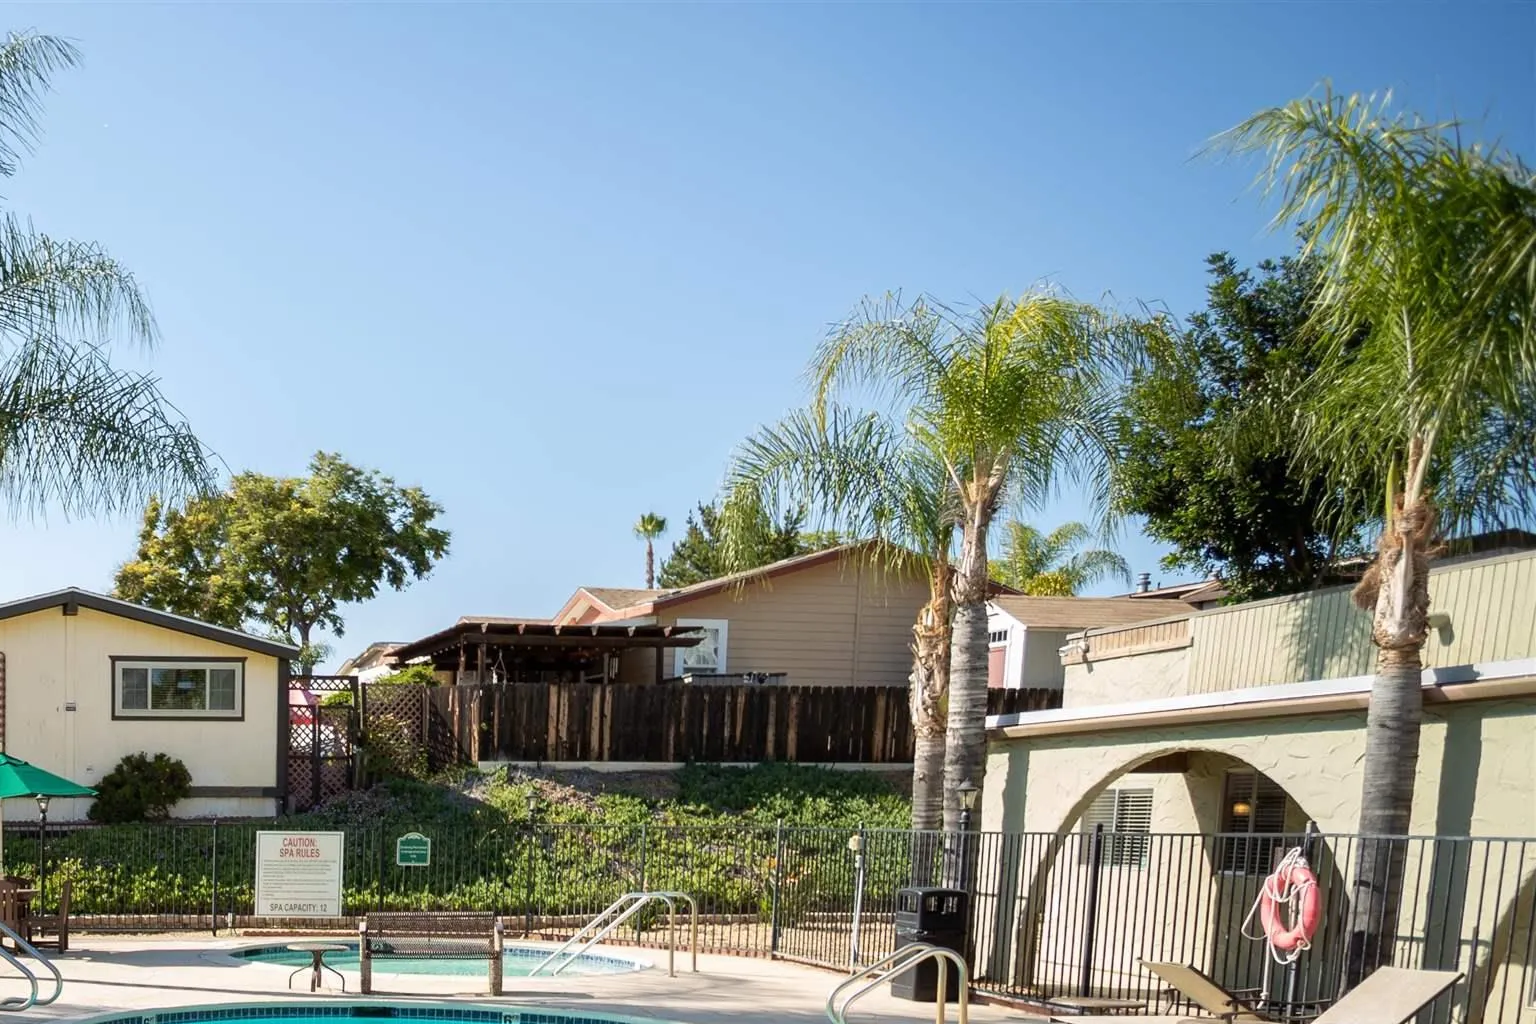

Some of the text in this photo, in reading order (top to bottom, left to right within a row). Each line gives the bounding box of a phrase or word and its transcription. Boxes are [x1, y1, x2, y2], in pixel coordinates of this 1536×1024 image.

[282, 837, 318, 848] CAUTION:
[279, 848, 321, 858] SPA RULES
[270, 903, 283, 912] SPA
[320, 903, 327, 912] 12
